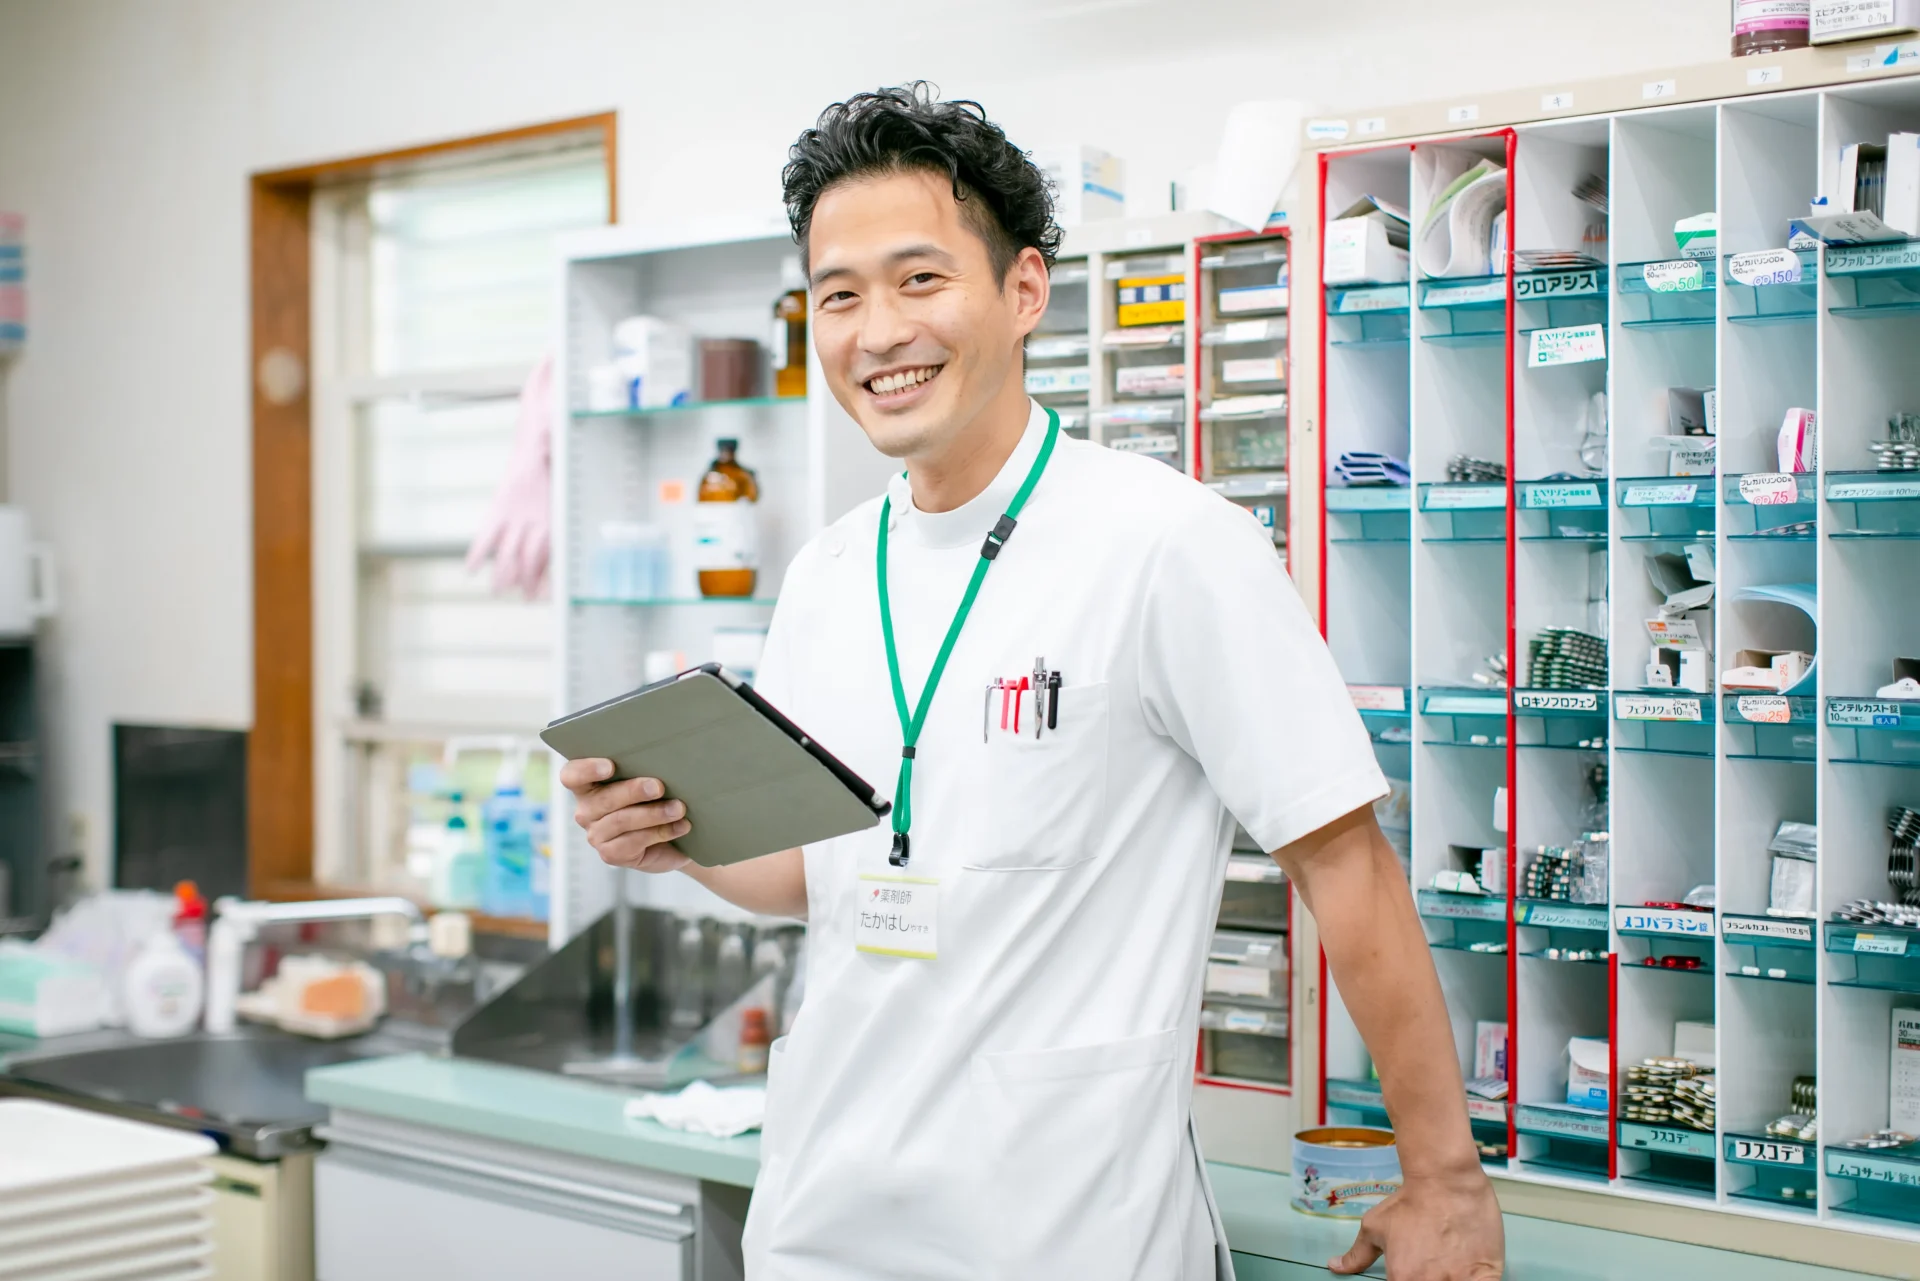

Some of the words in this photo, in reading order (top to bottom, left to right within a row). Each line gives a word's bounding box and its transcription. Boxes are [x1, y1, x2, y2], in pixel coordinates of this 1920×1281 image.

[1903, 251, 1920, 264] 20
[1773, 269, 1793, 283] 150
[1517, 273, 1595, 296] ウロアシス
[1678, 277, 1696, 289] 50
[1772, 491, 1788, 504] 75
[1830, 703, 1899, 714] モンテルカスト錠
[1767, 710, 1783, 722] 25
[880, 889, 912, 905] 薬剤師
[860, 911, 910, 932] たかはし
[1624, 915, 1708, 932] メコバラミン錠
